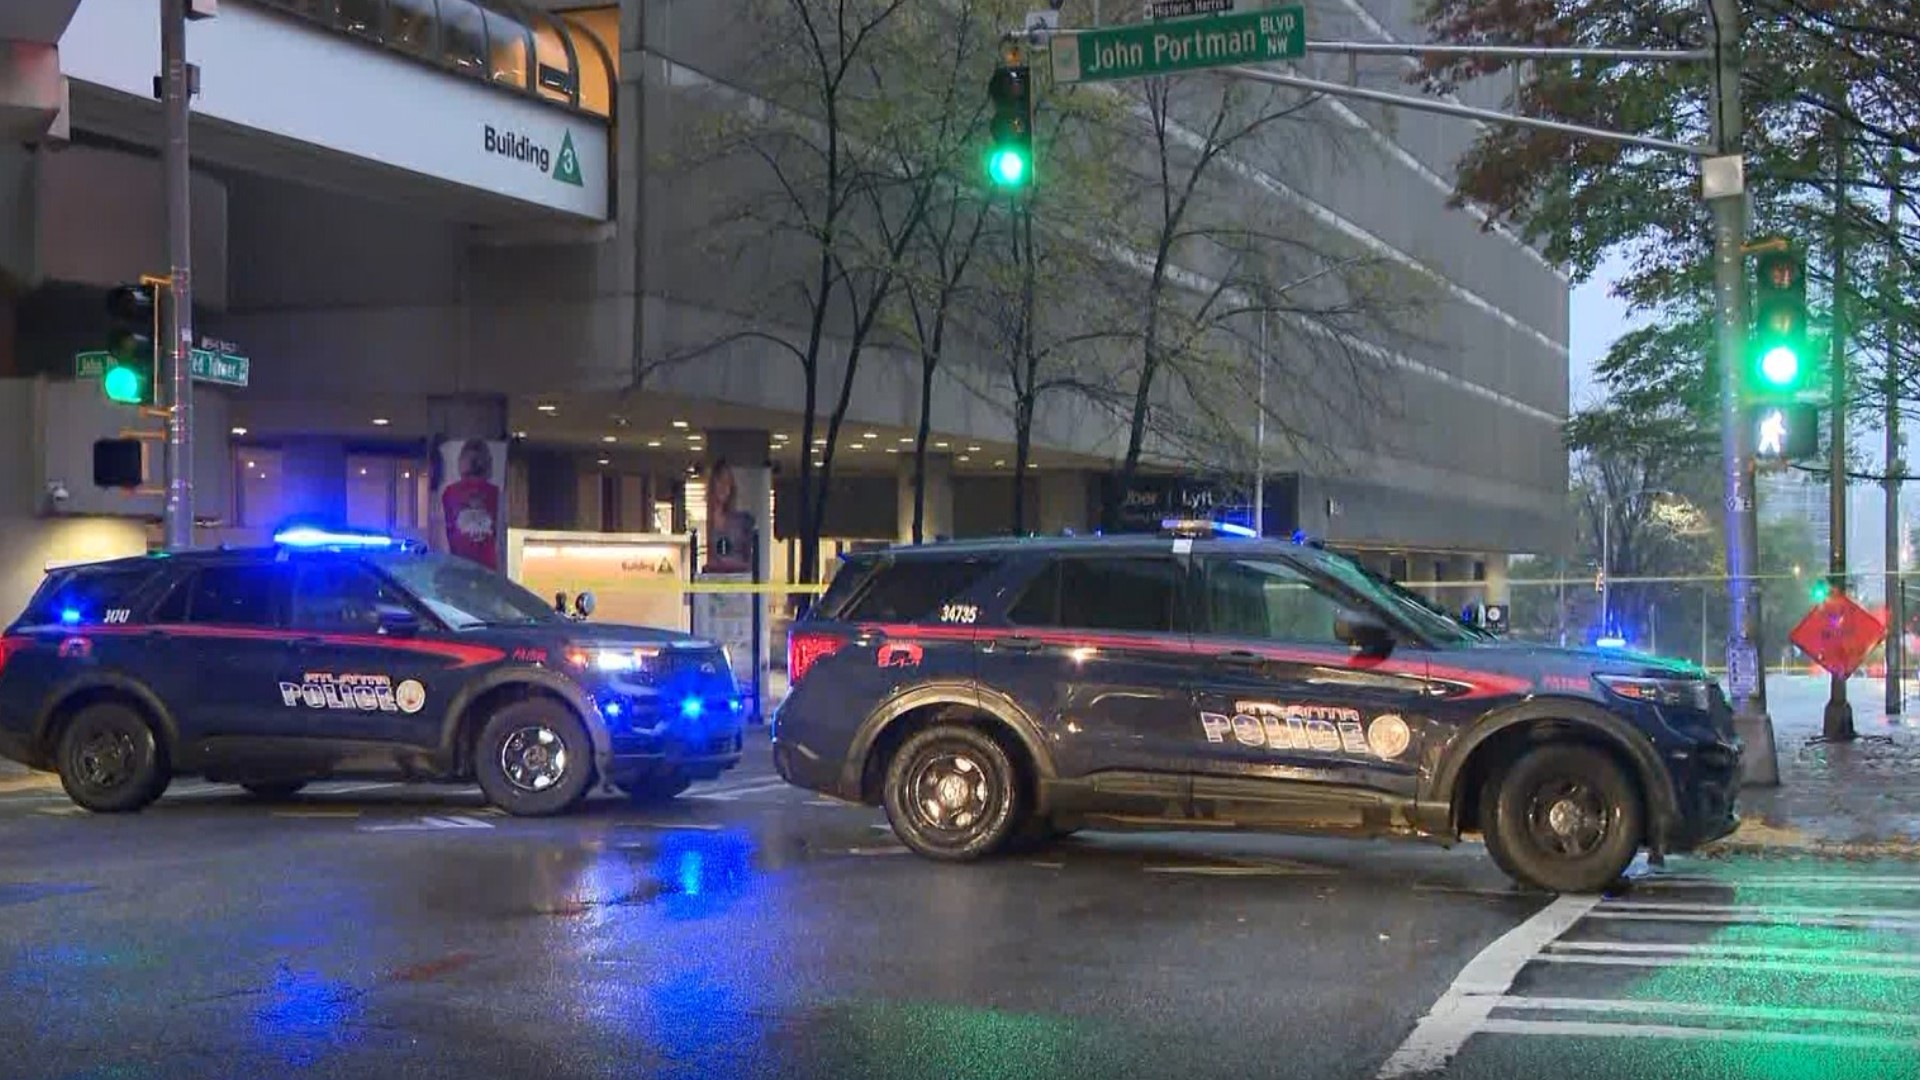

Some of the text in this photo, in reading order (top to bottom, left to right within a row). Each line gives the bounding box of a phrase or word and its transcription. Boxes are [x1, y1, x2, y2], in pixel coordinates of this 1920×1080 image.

[1260, 15, 1295, 35] BLVD
[1090, 30, 1256, 71] John Portman
[1267, 37, 1289, 55] NW
[484, 124, 573, 174] Building 3
[1182, 489, 1212, 508] Lyft
[279, 682, 398, 711] POLICE
[1200, 711, 1371, 753] POLICE
